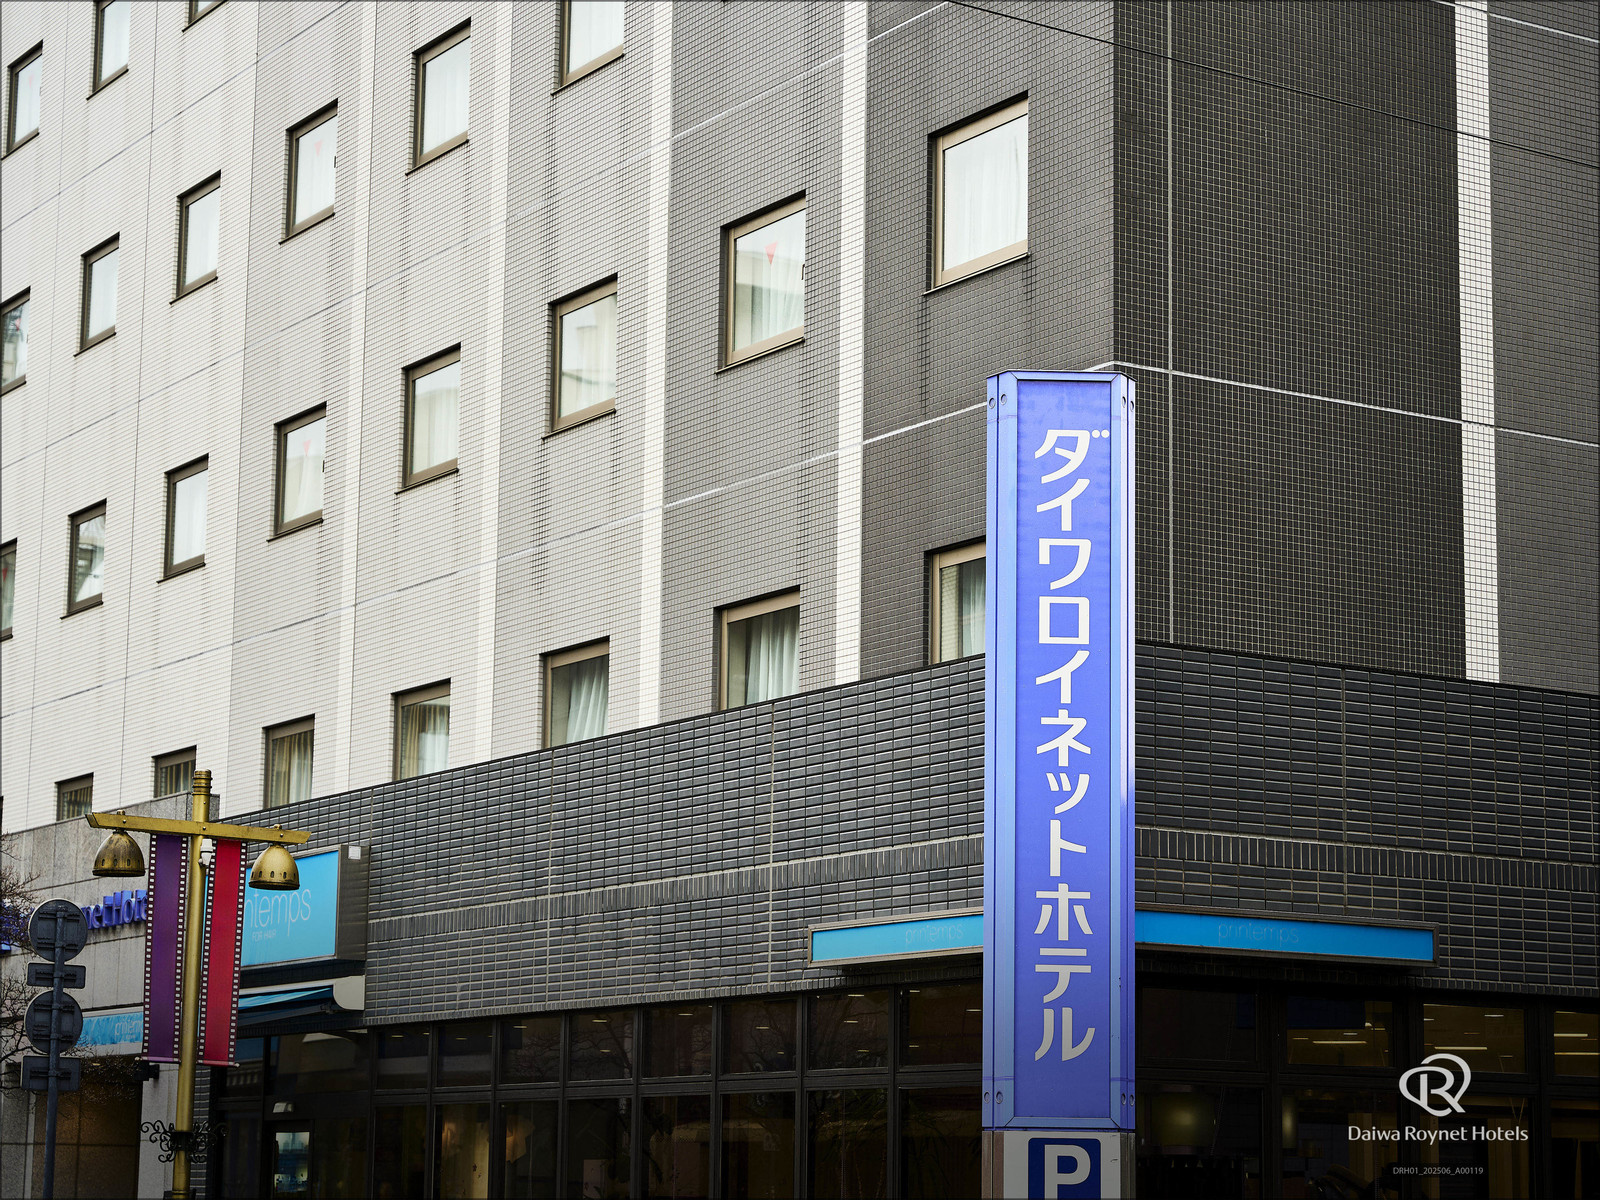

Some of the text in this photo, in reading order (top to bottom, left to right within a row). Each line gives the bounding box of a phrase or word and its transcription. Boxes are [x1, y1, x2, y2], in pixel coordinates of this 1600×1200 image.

[1034, 429, 1110, 1062] ダイワロイネットホテル
[243, 888, 312, 937] ntemps
[1218, 922, 1299, 947] printemps
[1044, 1144, 1091, 1200] P
